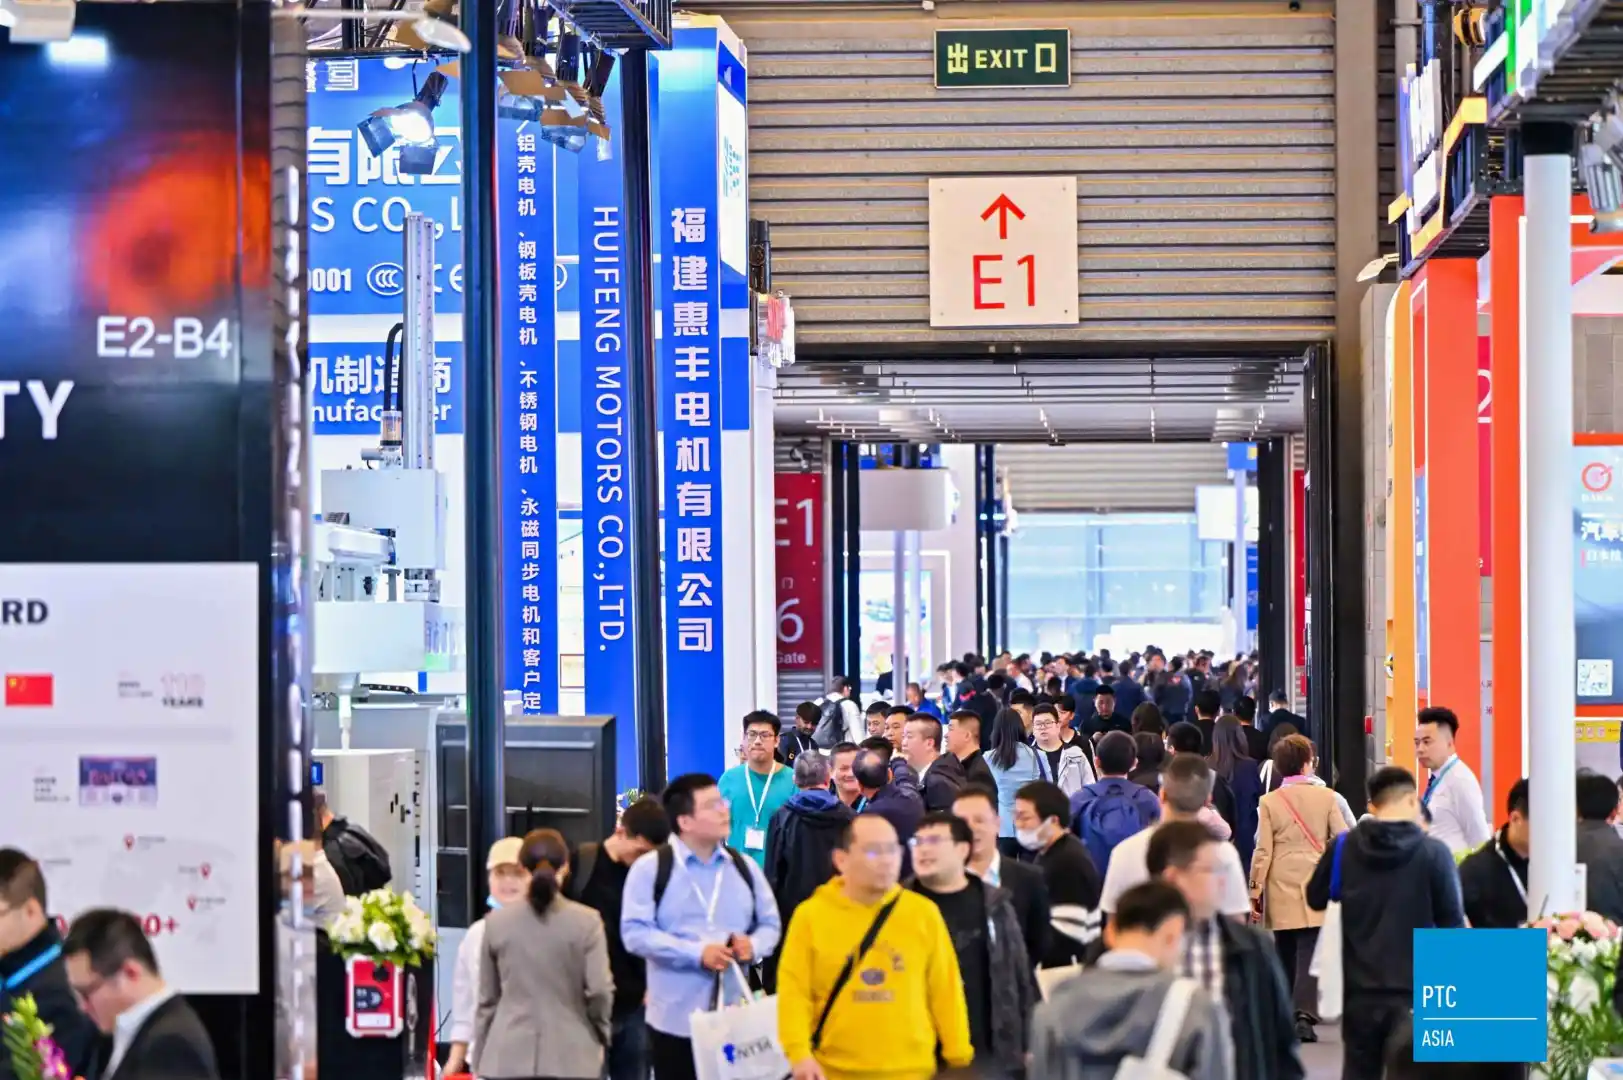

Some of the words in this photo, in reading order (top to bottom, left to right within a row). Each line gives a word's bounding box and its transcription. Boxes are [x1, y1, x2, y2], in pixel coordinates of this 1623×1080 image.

[947, 43, 968, 74] 出
[975, 48, 1028, 69] EXIT
[1035, 43, 1057, 73] 口
[593, 206, 621, 353] HUIFENG
[972, 254, 1036, 310] E1
[97, 315, 233, 359] E2-B4
[595, 366, 624, 504] MOTORS
[671, 207, 713, 653] 福建惠丰电机有限公司
[592, 514, 625, 652] CO.,LTD.
[776, 598, 804, 643] 6
